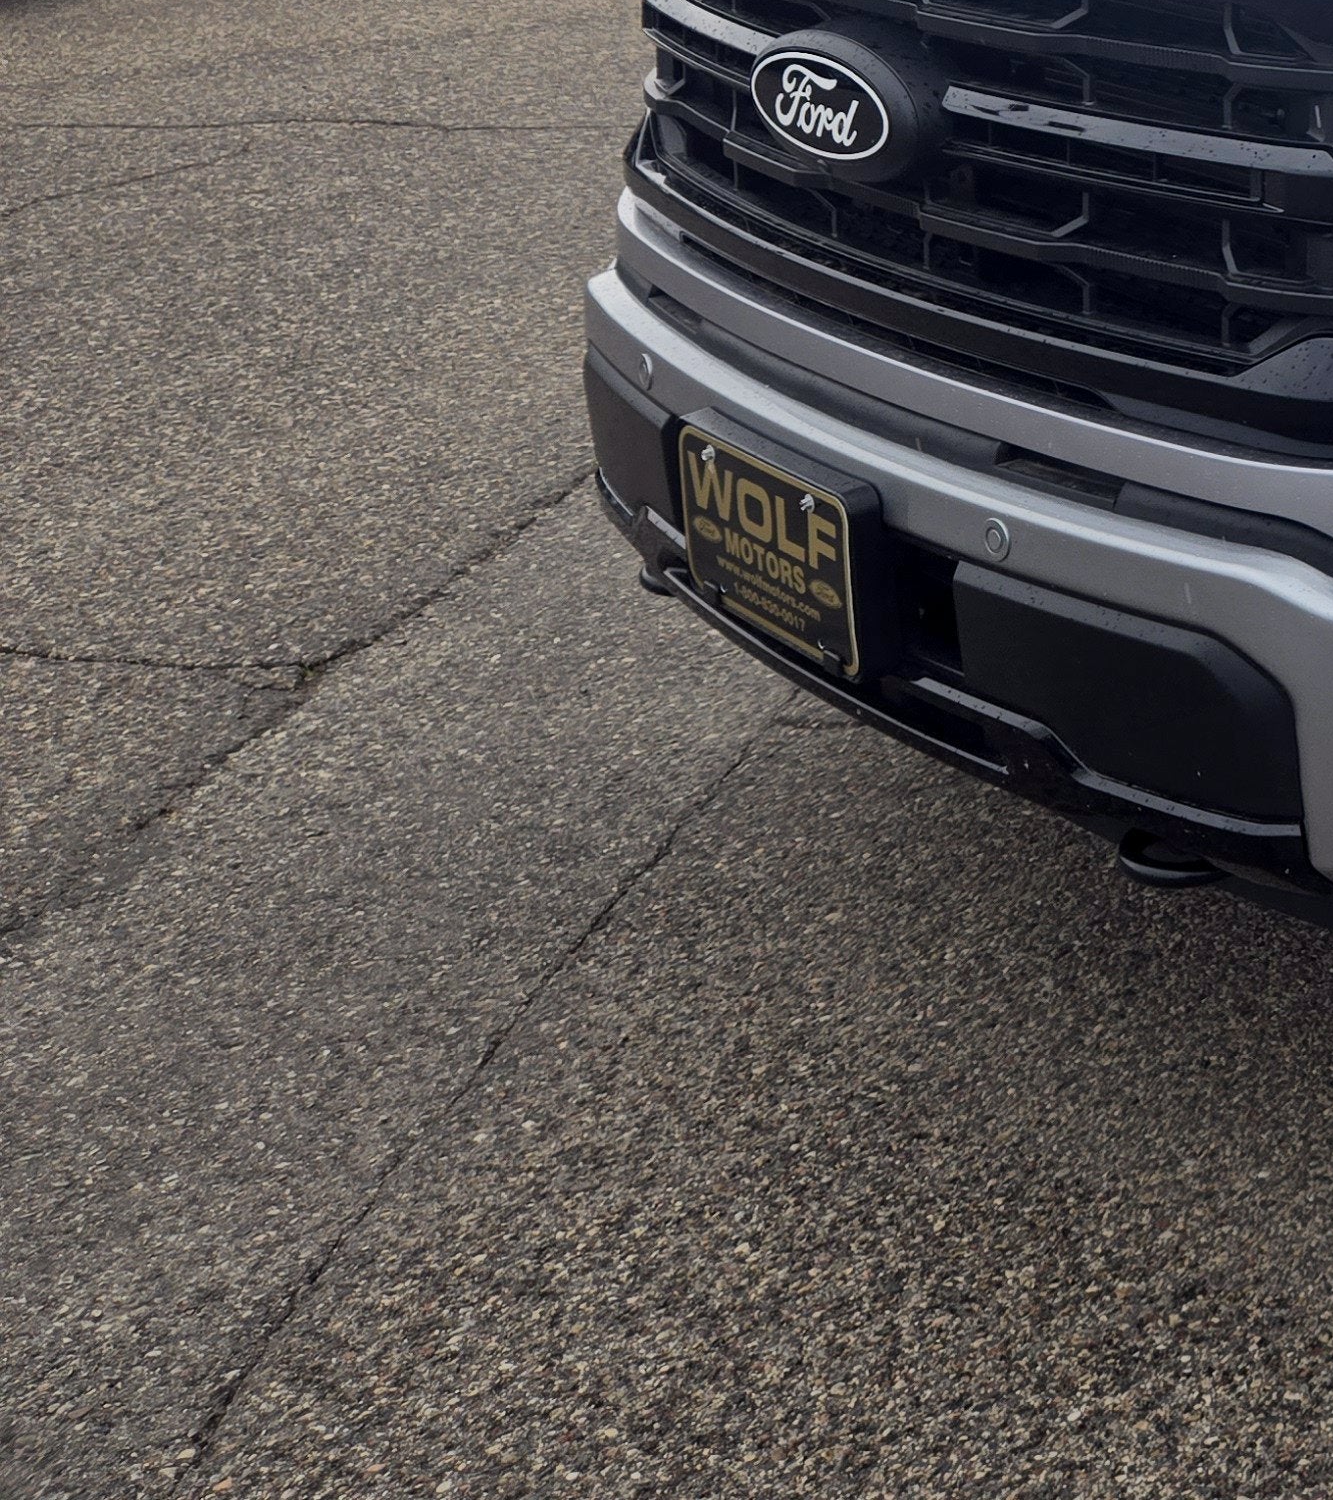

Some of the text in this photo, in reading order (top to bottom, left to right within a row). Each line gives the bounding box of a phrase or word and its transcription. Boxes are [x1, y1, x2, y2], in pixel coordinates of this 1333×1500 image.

[775, 64, 859, 147] Ford
[687, 451, 836, 569] WOLF
[724, 527, 806, 594] MOTORS
